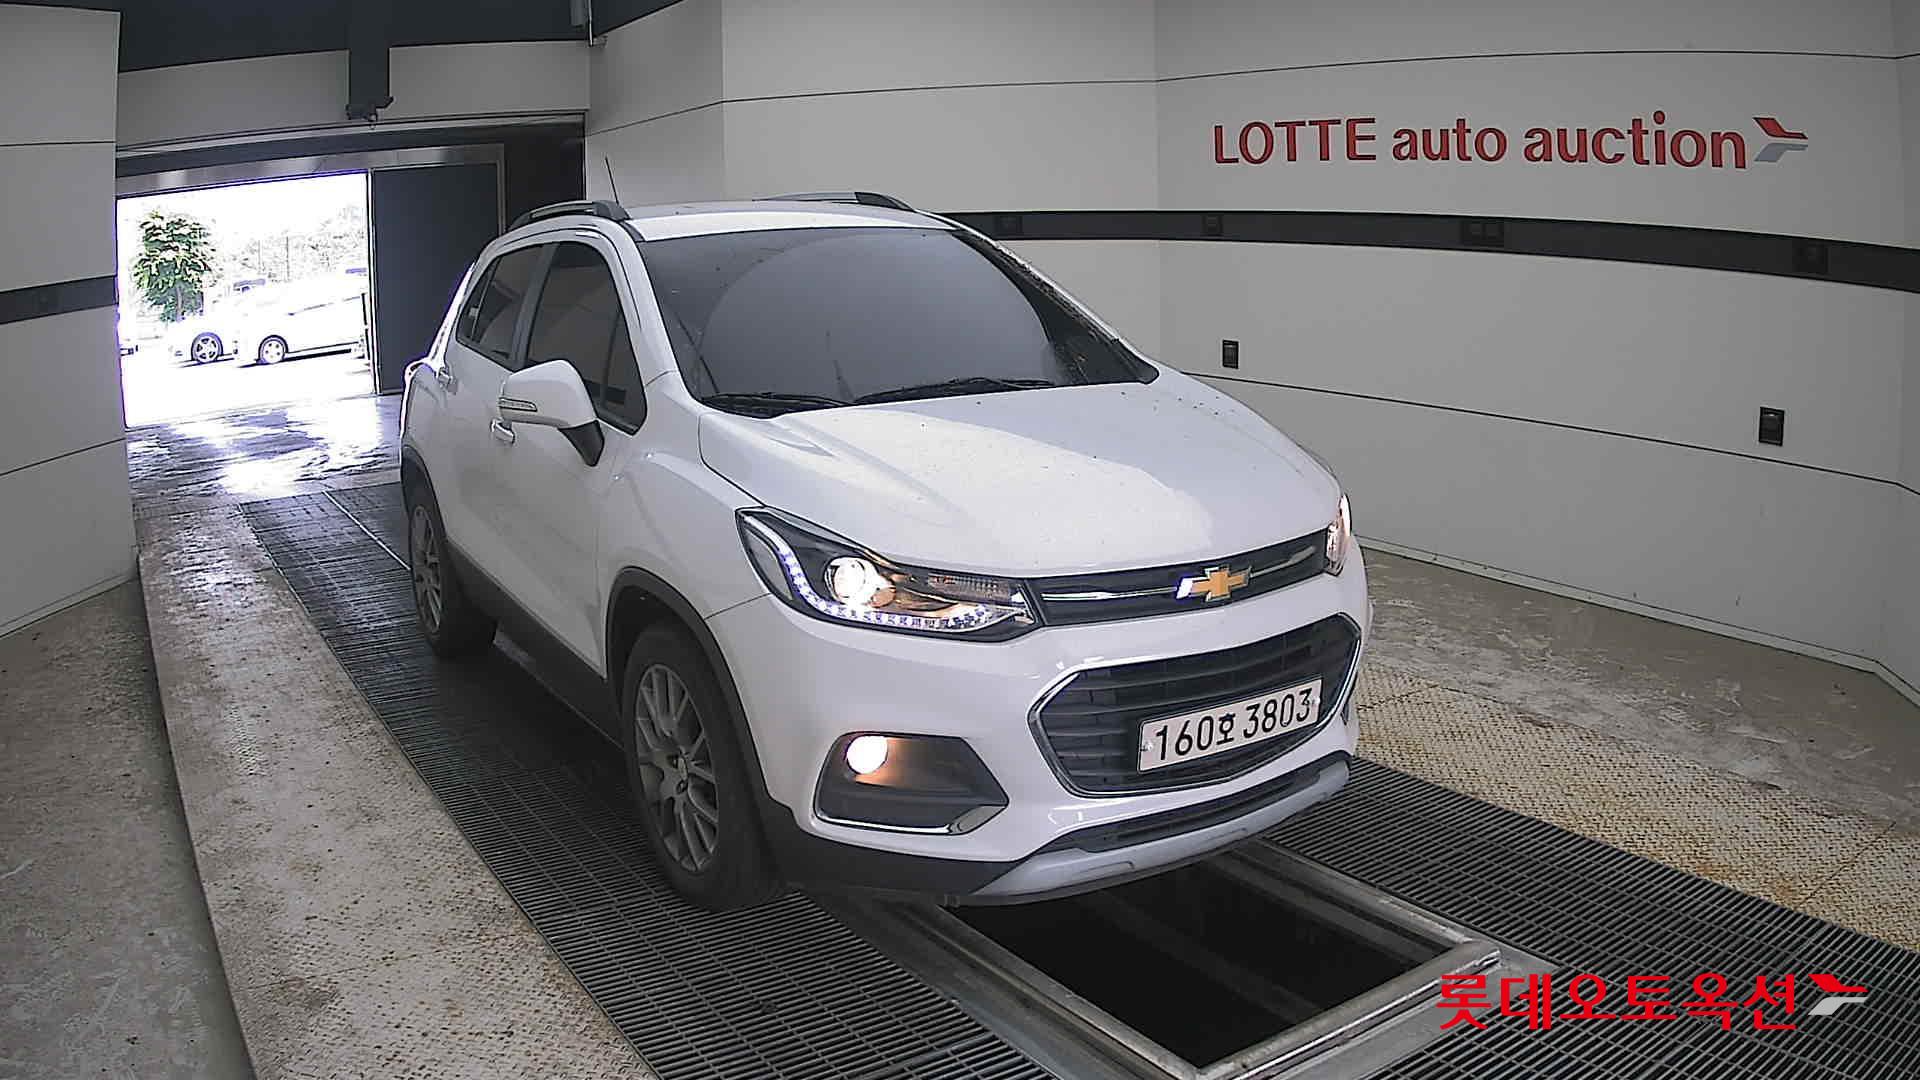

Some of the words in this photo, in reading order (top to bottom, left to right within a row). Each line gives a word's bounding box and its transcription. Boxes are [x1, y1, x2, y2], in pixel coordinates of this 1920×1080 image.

[1213, 117, 1377, 165] LOTTE
[1392, 118, 1508, 163] auto
[1523, 110, 1747, 169] auction
[1155, 713, 1236, 761] 160호
[1243, 687, 1313, 739] 3803
